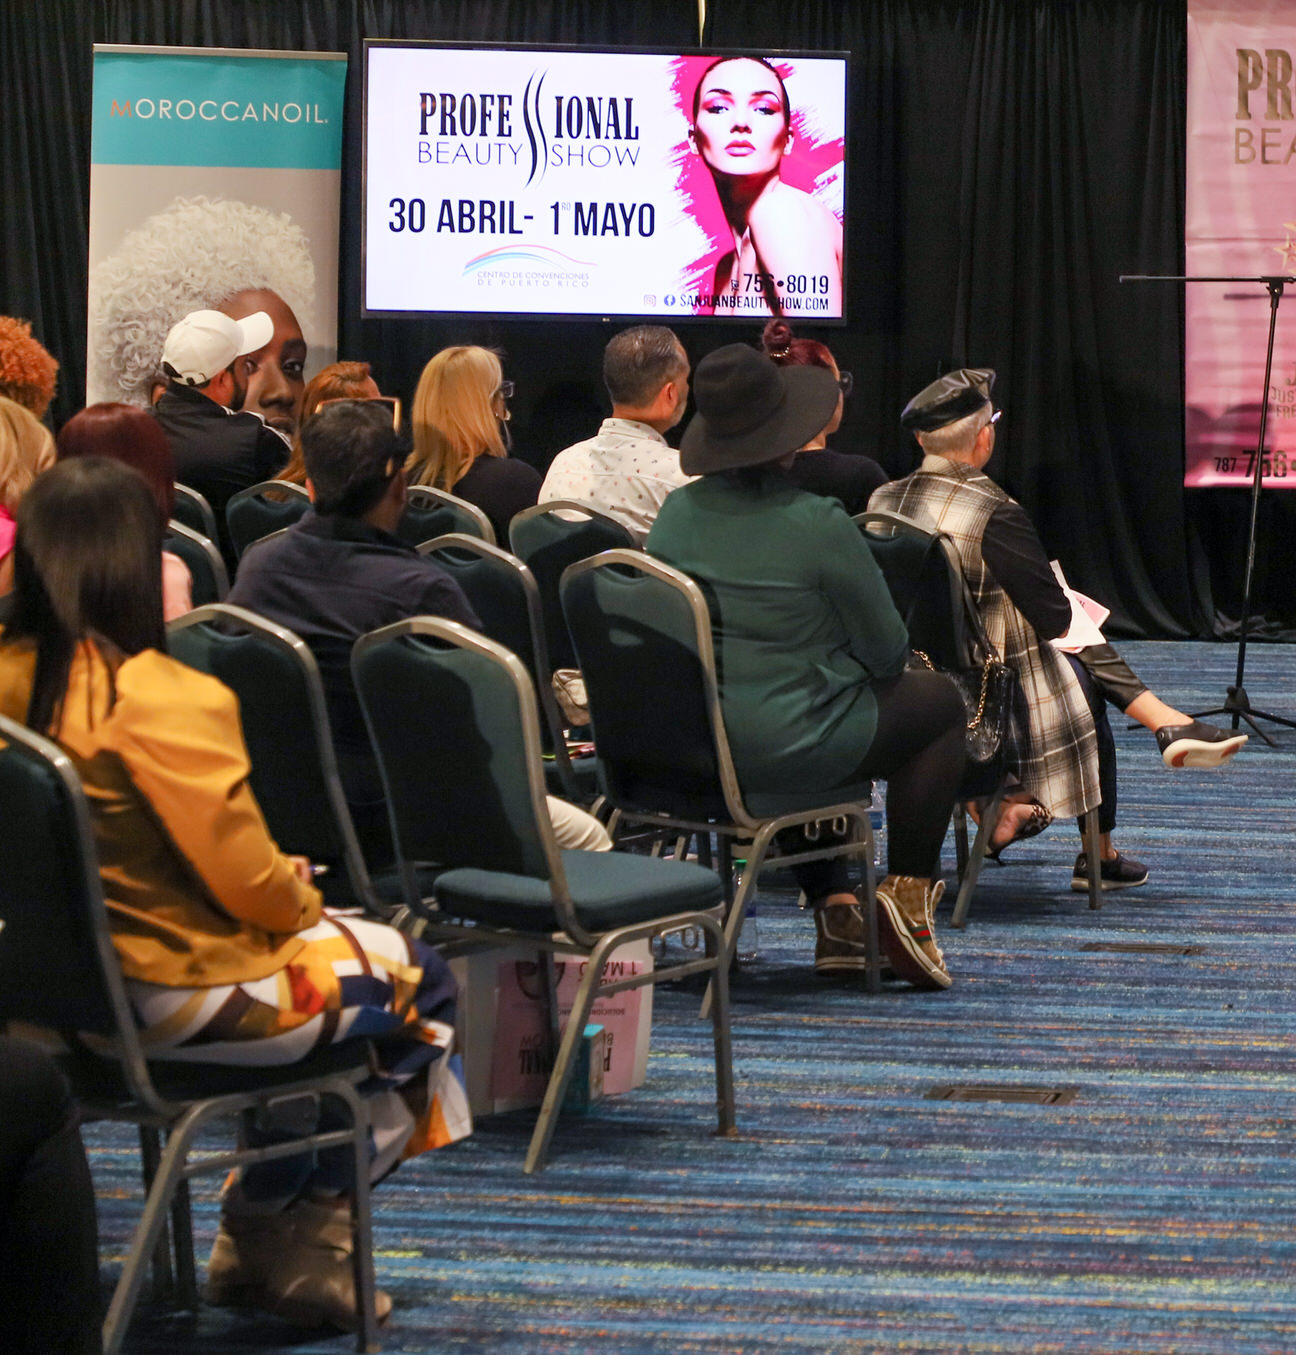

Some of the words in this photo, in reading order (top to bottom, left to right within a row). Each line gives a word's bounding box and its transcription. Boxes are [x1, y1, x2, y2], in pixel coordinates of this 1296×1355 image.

[418, 141, 523, 165] BEAUTY
[550, 143, 641, 168] SHOW
[388, 197, 426, 233] 30
[436, 199, 534, 234] ABRIL-
[574, 201, 656, 237] MAYO
[476, 271, 511, 279] CENTRO
[512, 271, 523, 279] DE
[525, 272, 590, 280] CONVENCIONES
[501, 279, 550, 287] PUERTO
[557, 280, 589, 288] RICO
[1214, 457, 1237, 473] 787
